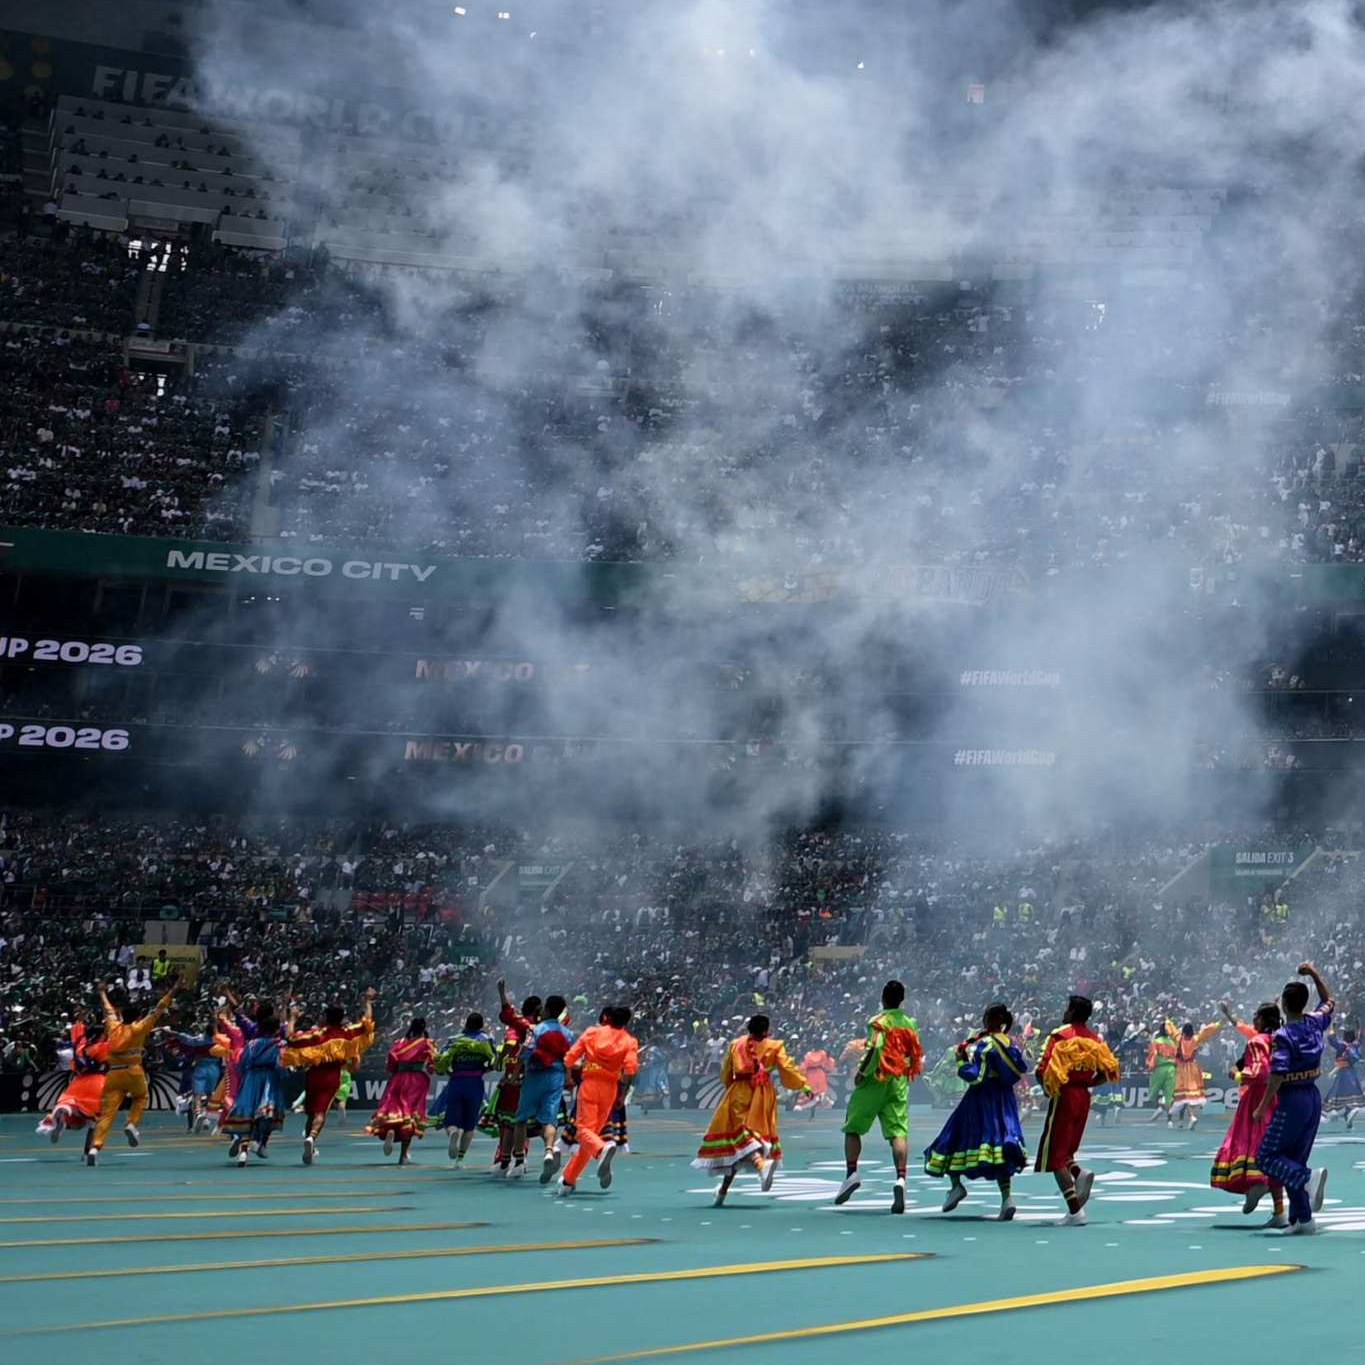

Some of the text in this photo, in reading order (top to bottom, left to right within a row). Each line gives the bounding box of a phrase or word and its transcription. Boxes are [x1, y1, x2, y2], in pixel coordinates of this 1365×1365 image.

[91, 65, 197, 106] FIFA
[166, 550, 438, 582] MEXICO CITY
[33, 639, 144, 665] 2026
[959, 670, 1061, 688] #FIFAWorldCup
[18, 725, 129, 750] 2026
[1235, 852, 1266, 864] SALIDA
[1267, 851, 1287, 864] EXIT
